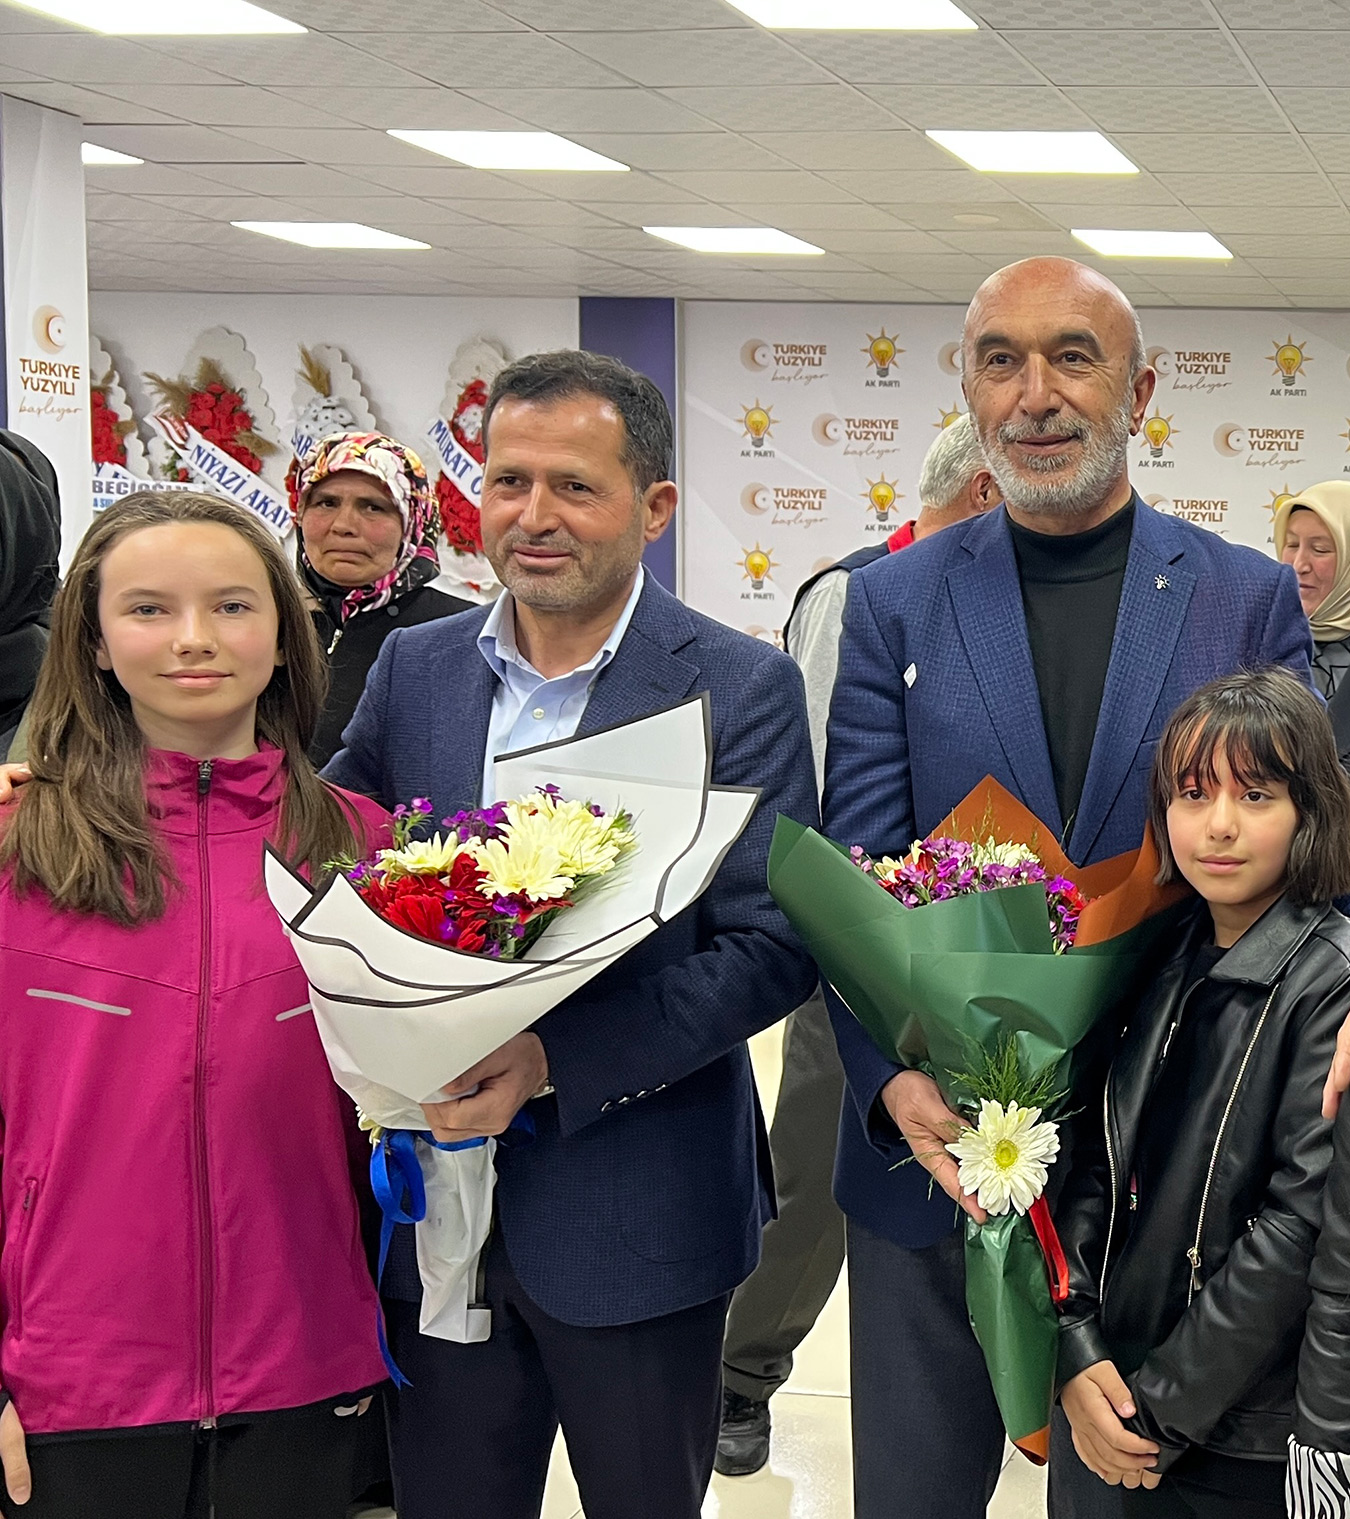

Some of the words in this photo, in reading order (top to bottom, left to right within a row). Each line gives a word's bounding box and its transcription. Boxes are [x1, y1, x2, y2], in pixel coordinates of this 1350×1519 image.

[428, 419, 473, 478] MURAT
[740, 450, 750, 458] AK
[242, 489, 291, 528] AKAY
[865, 524, 875, 532] AK
[740, 592, 751, 600] AK
